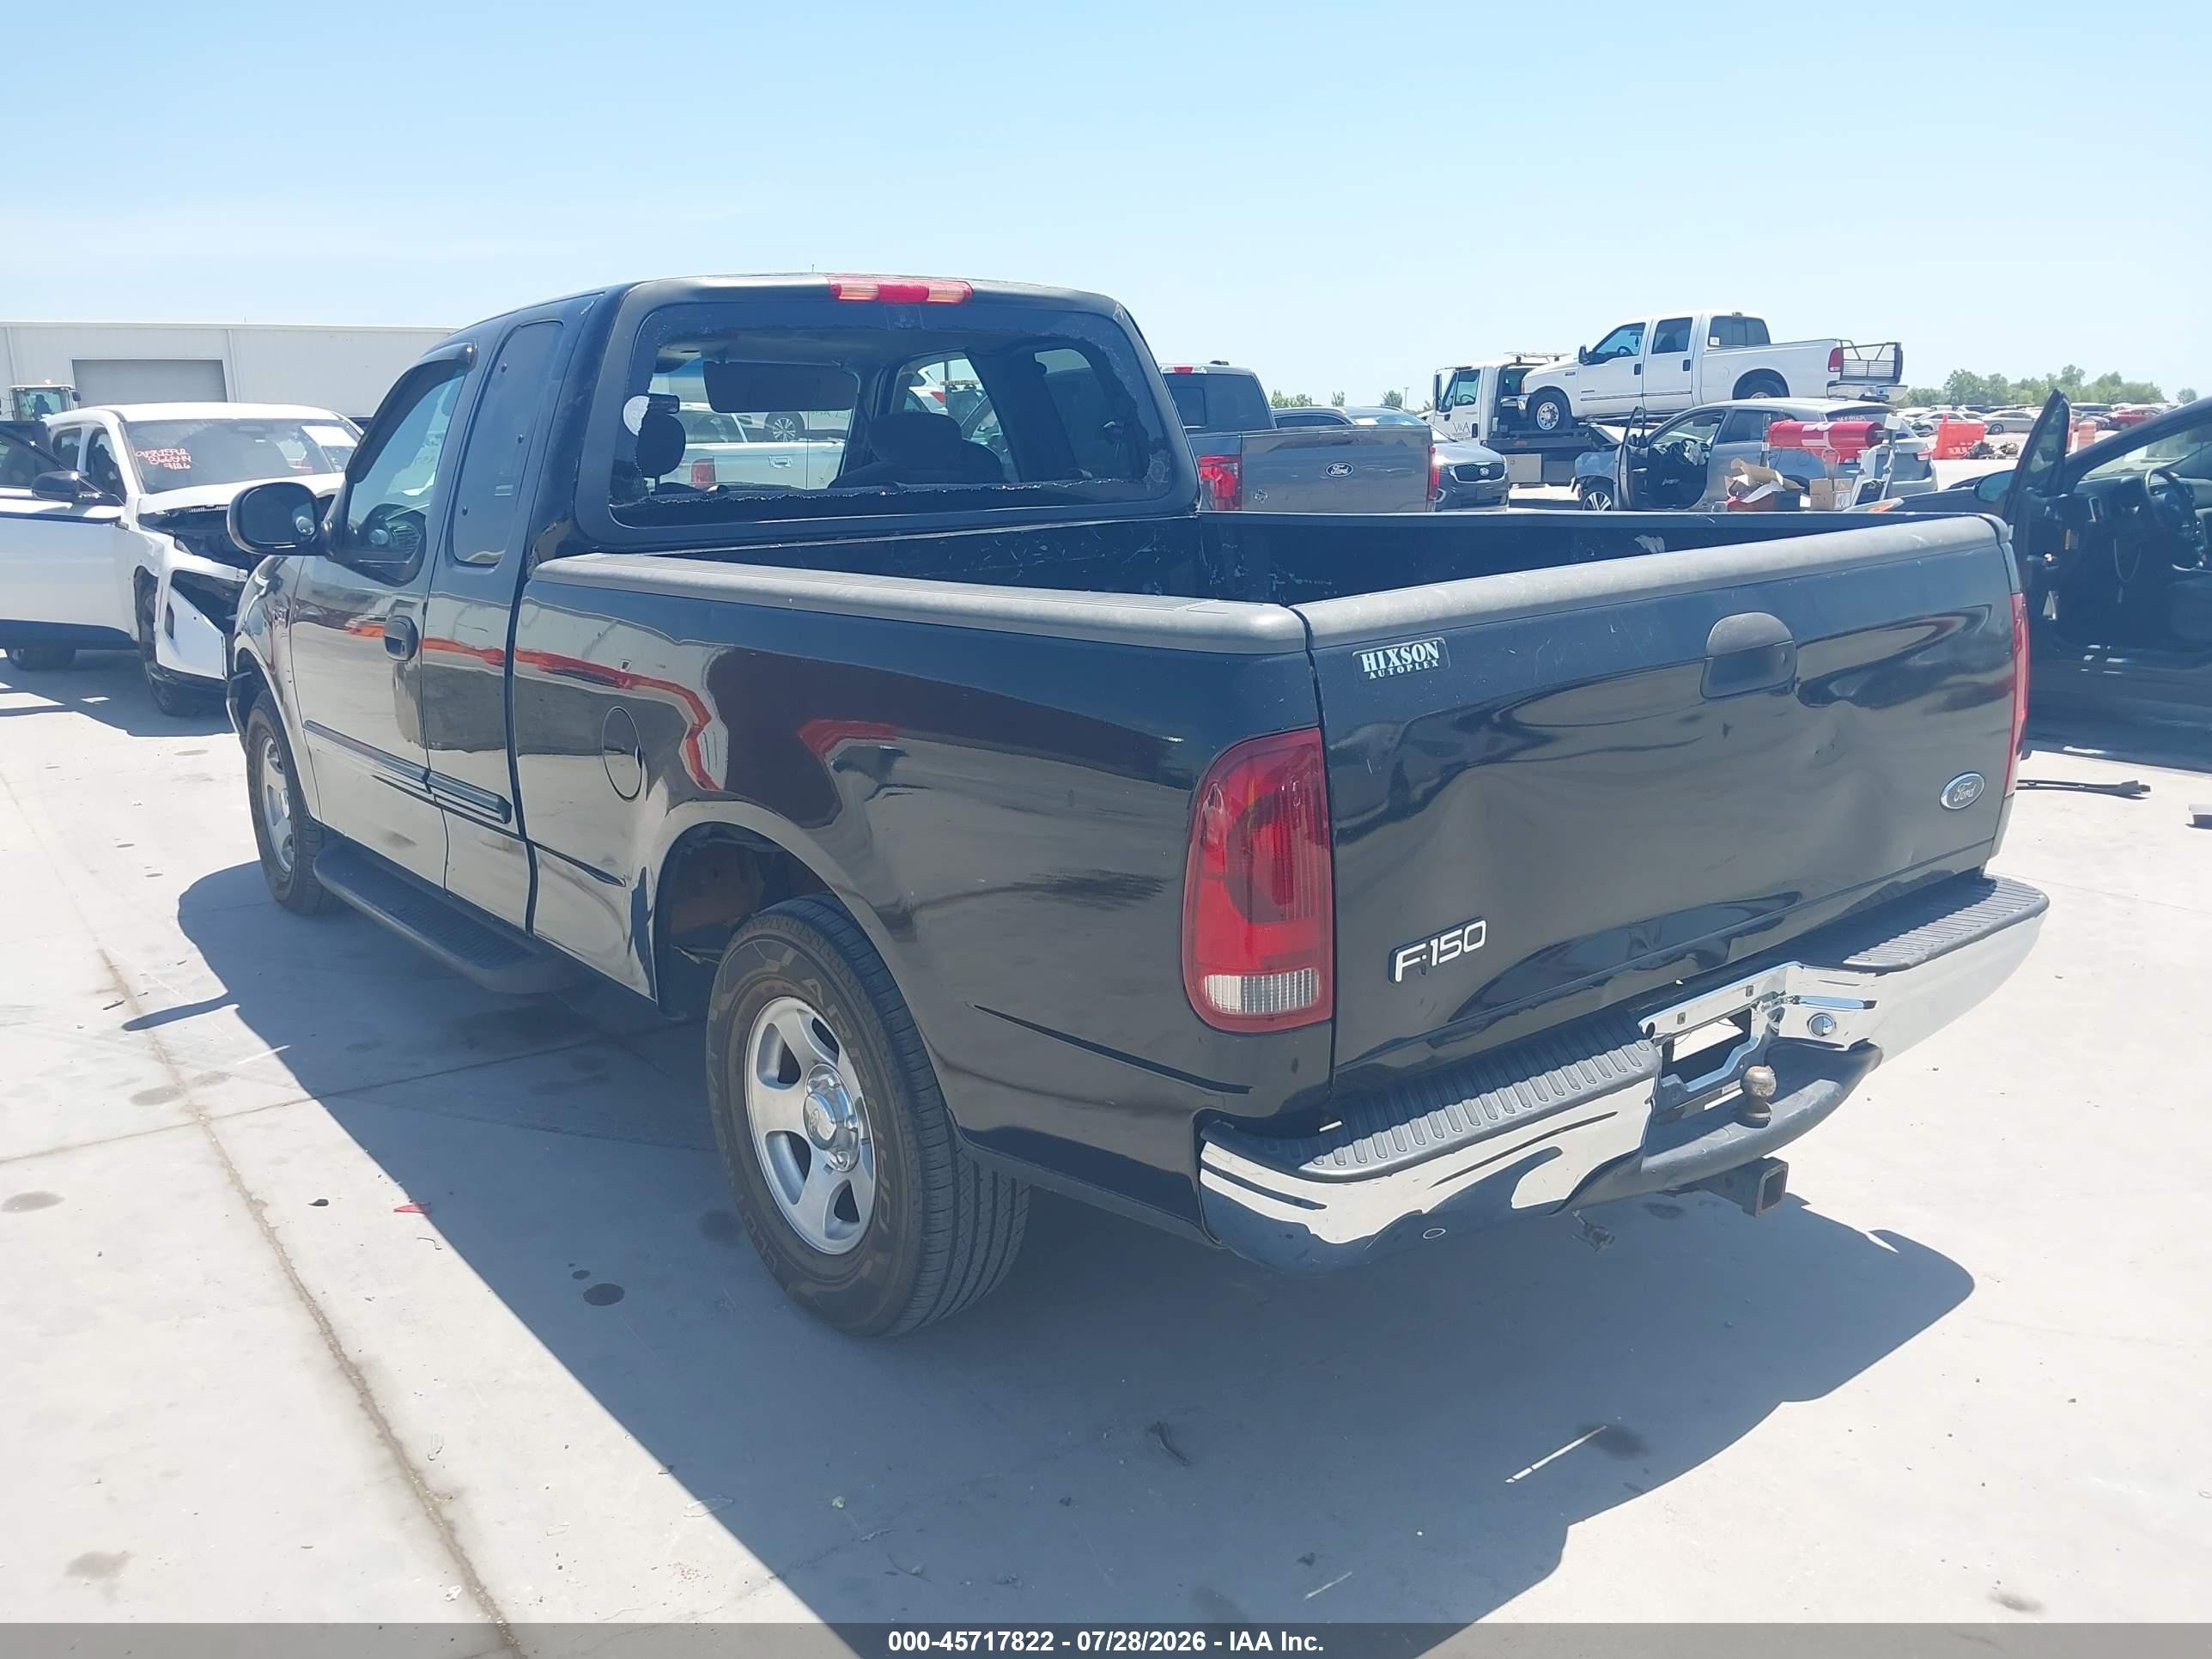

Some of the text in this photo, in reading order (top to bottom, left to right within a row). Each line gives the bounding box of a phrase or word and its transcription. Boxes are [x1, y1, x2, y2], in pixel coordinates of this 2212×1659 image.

[1330, 465, 1349, 475] Ford
[1360, 641, 1440, 672] HIXSON
[1369, 659, 1439, 679] AUTOPLEX
[1954, 781, 1977, 803] Ford
